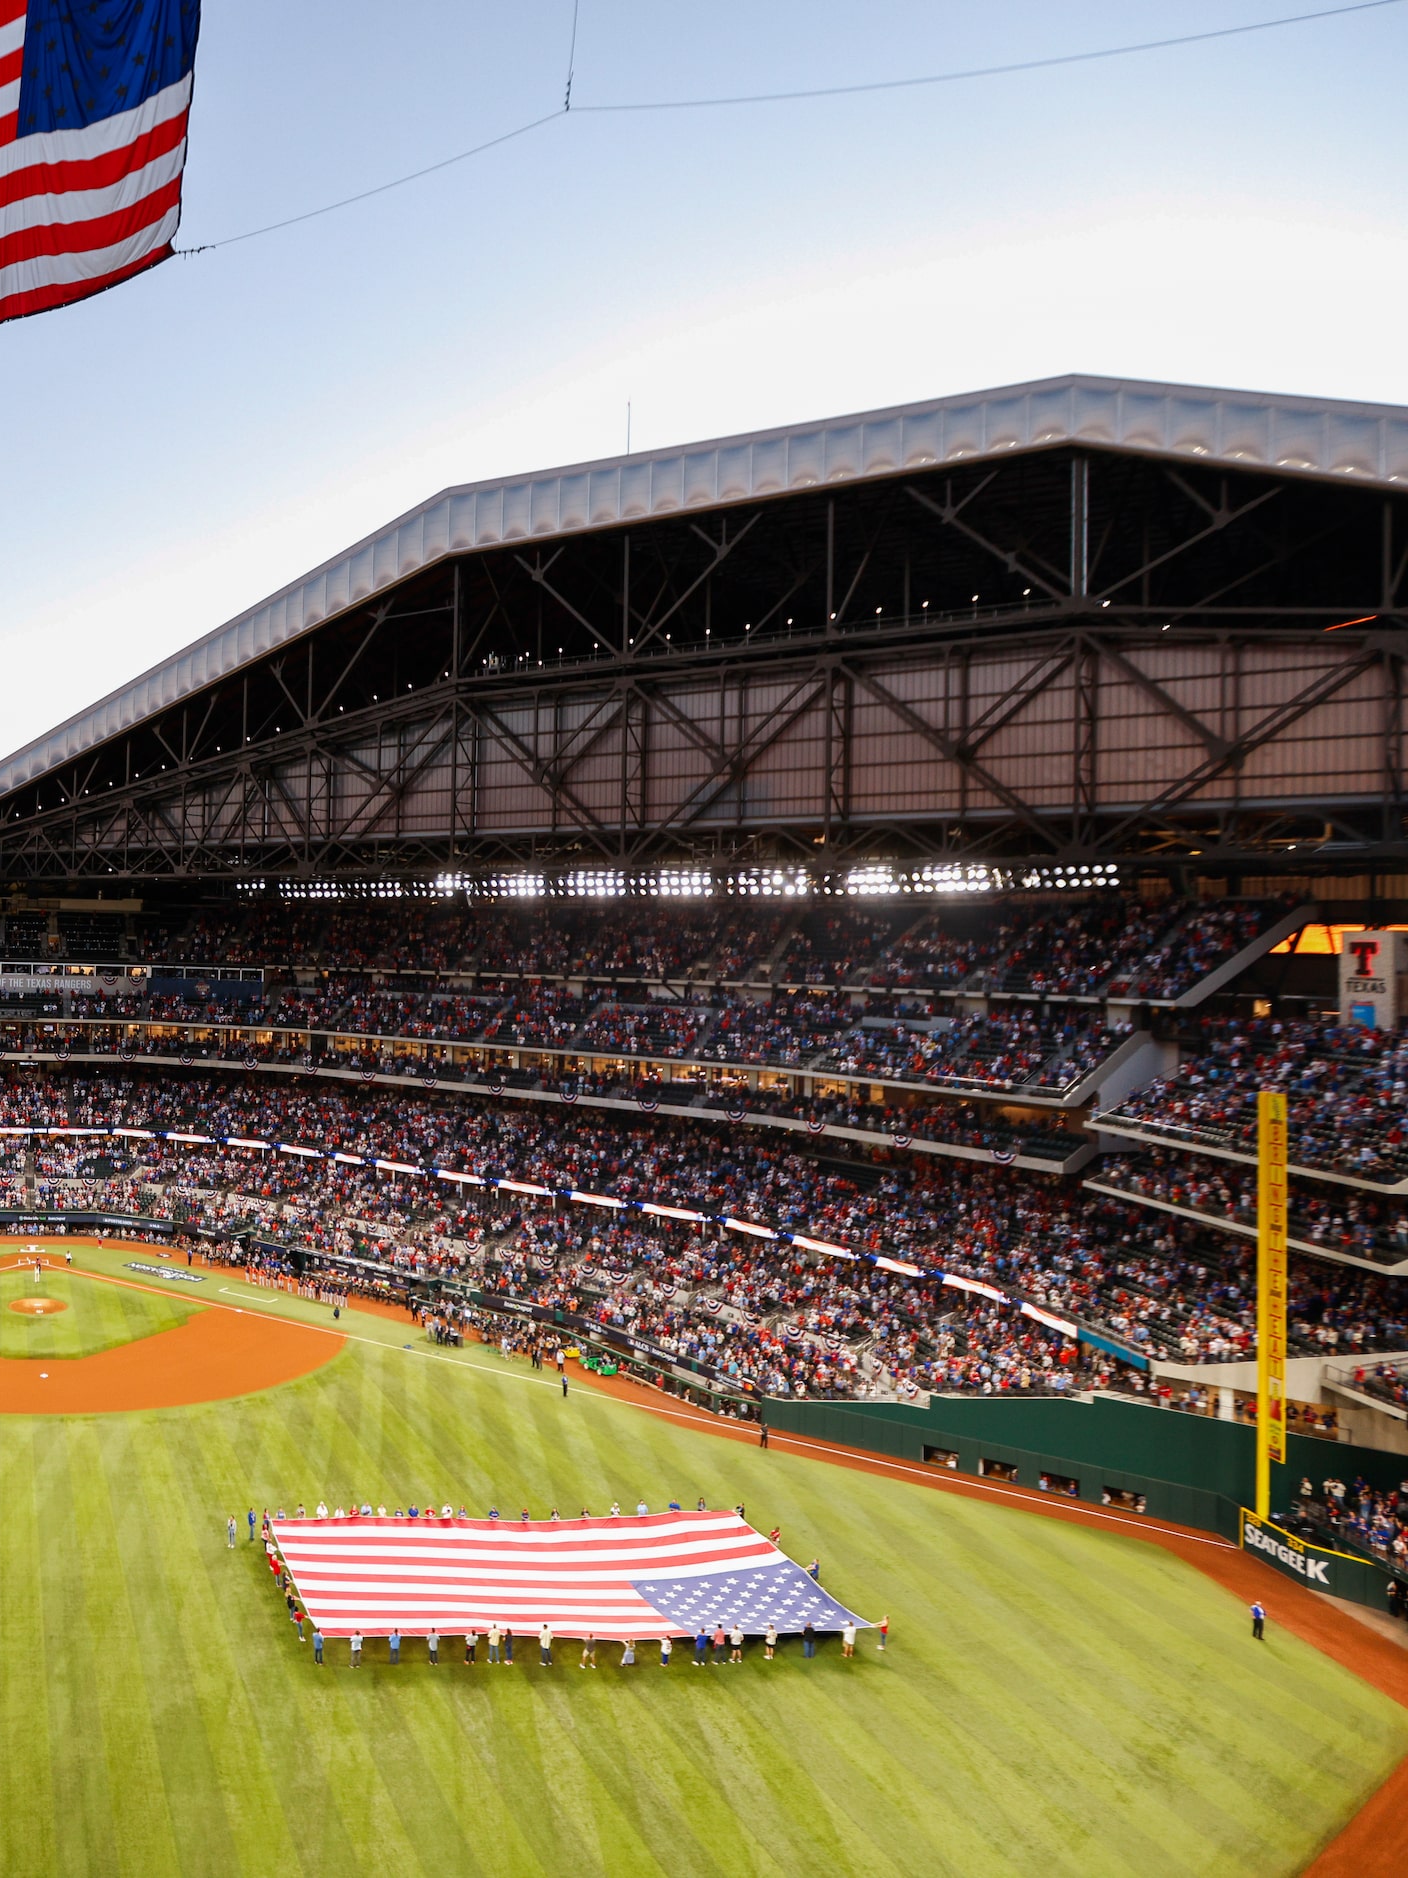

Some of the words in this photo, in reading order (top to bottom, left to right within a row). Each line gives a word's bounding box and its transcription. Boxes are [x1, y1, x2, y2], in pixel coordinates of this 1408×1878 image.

[1349, 940, 1380, 976] T
[8, 978, 24, 988] THE
[27, 978, 52, 989] TEXAS
[54, 979, 92, 989] RANGERS
[1345, 980, 1387, 994] TEXAS
[635, 1342, 650, 1353] ALCS
